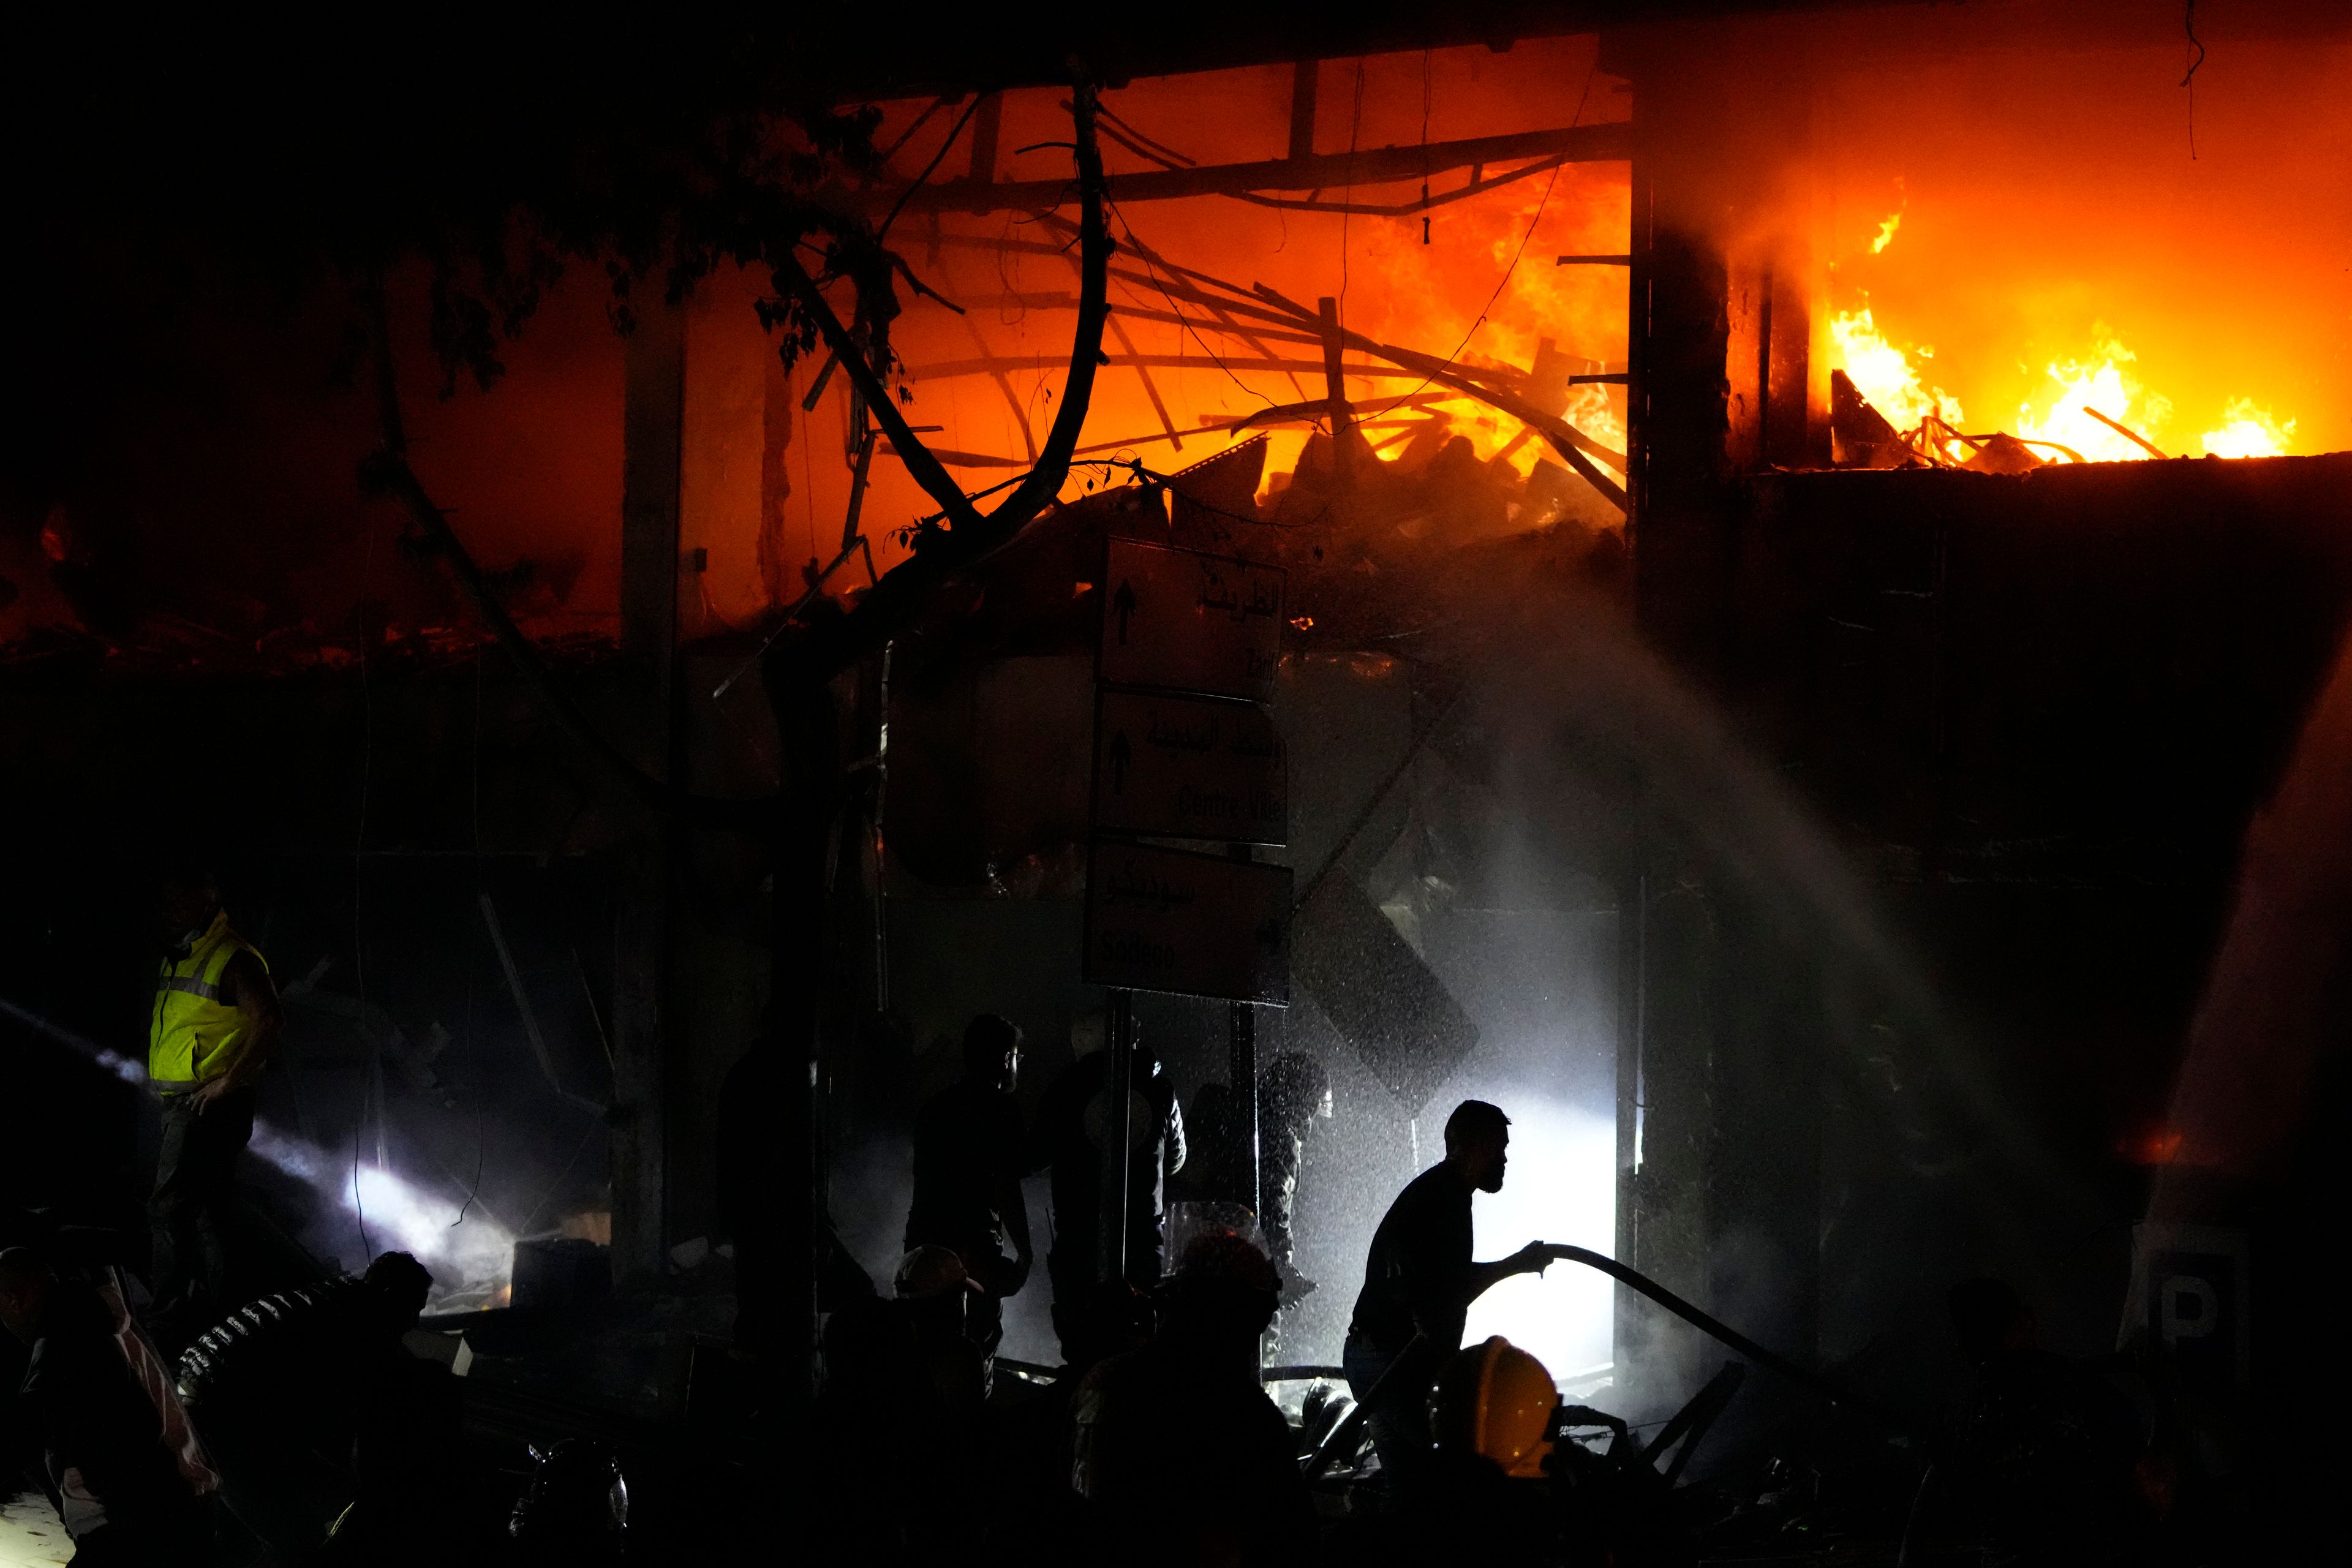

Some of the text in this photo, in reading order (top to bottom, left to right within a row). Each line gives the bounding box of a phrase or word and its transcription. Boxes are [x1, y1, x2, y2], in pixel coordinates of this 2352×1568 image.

[1147, 709, 1219, 760] المدينة
[1178, 783, 1281, 822] Centre Ville
[1103, 859, 1195, 913] سوديكو
[1101, 930, 1175, 970] Sodeco
[2161, 1275, 2218, 1351] P
